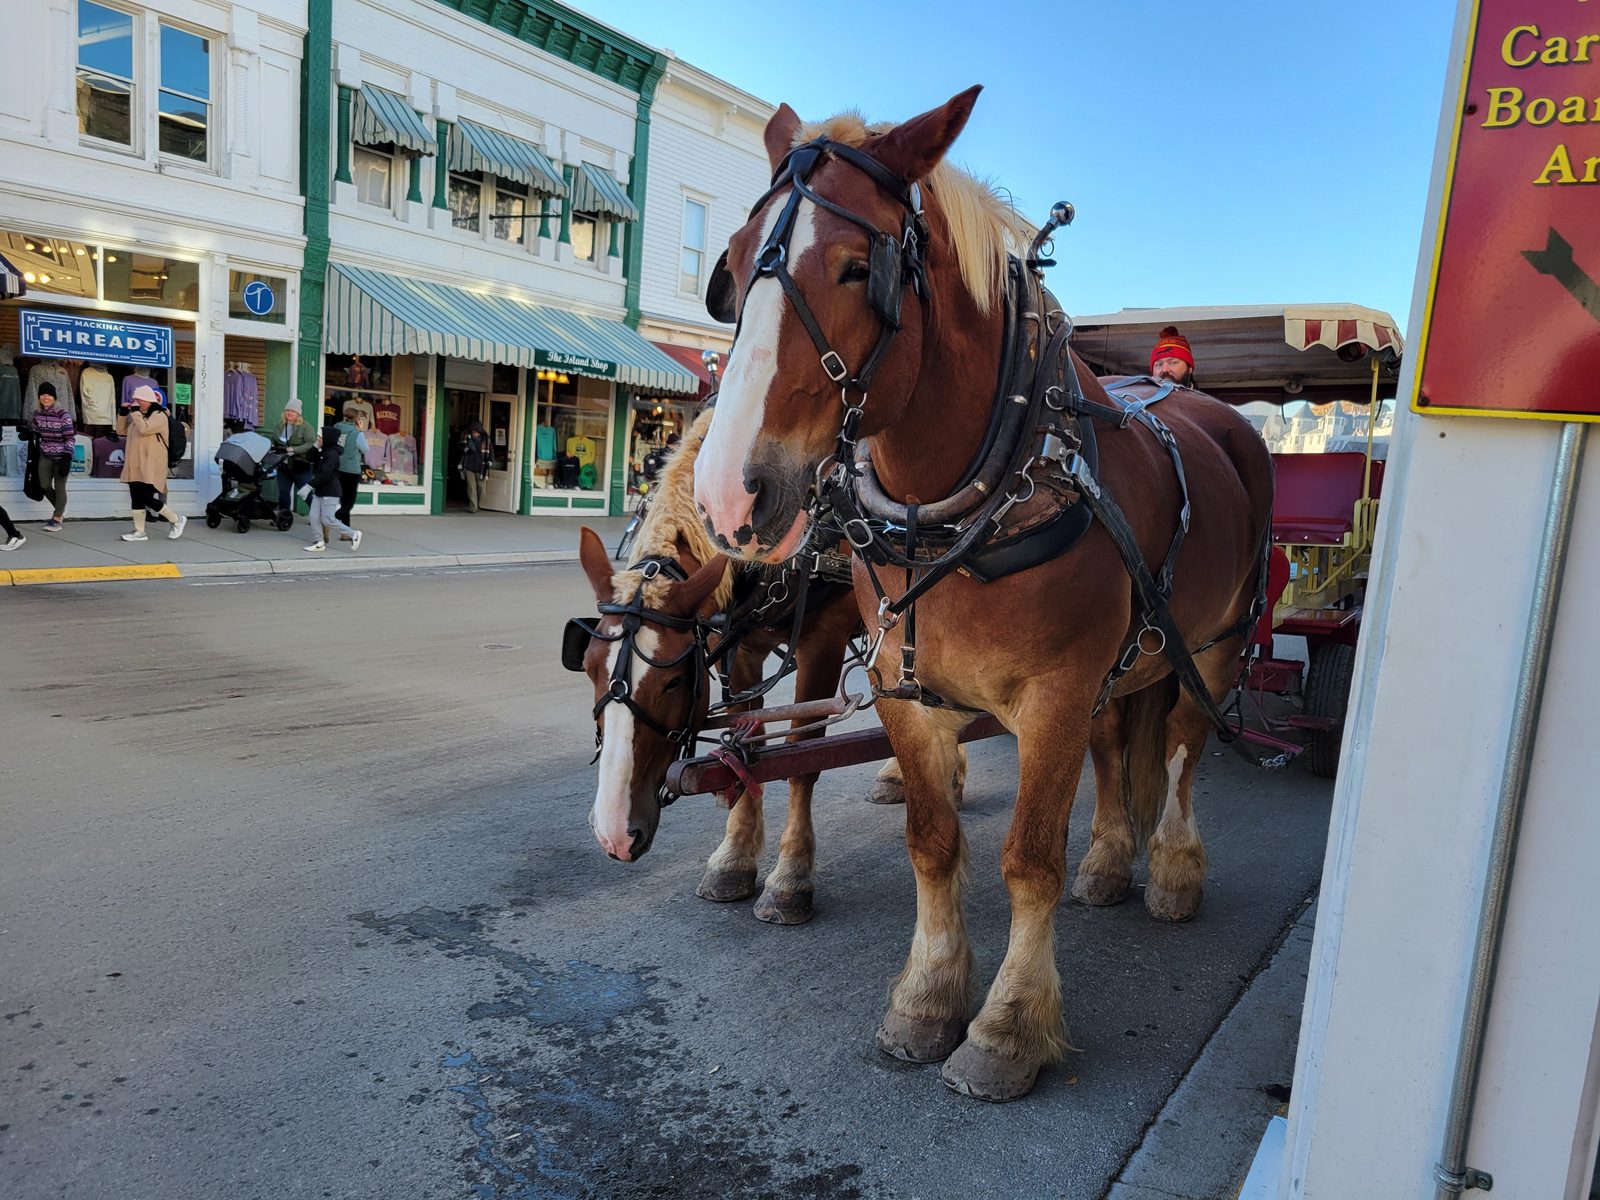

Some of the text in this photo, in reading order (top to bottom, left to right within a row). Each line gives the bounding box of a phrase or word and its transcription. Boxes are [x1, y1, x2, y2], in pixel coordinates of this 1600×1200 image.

[74, 320, 126, 332] MACKINAC
[40, 327, 157, 352] THREADS
[547, 351, 609, 373] The Island Shop
